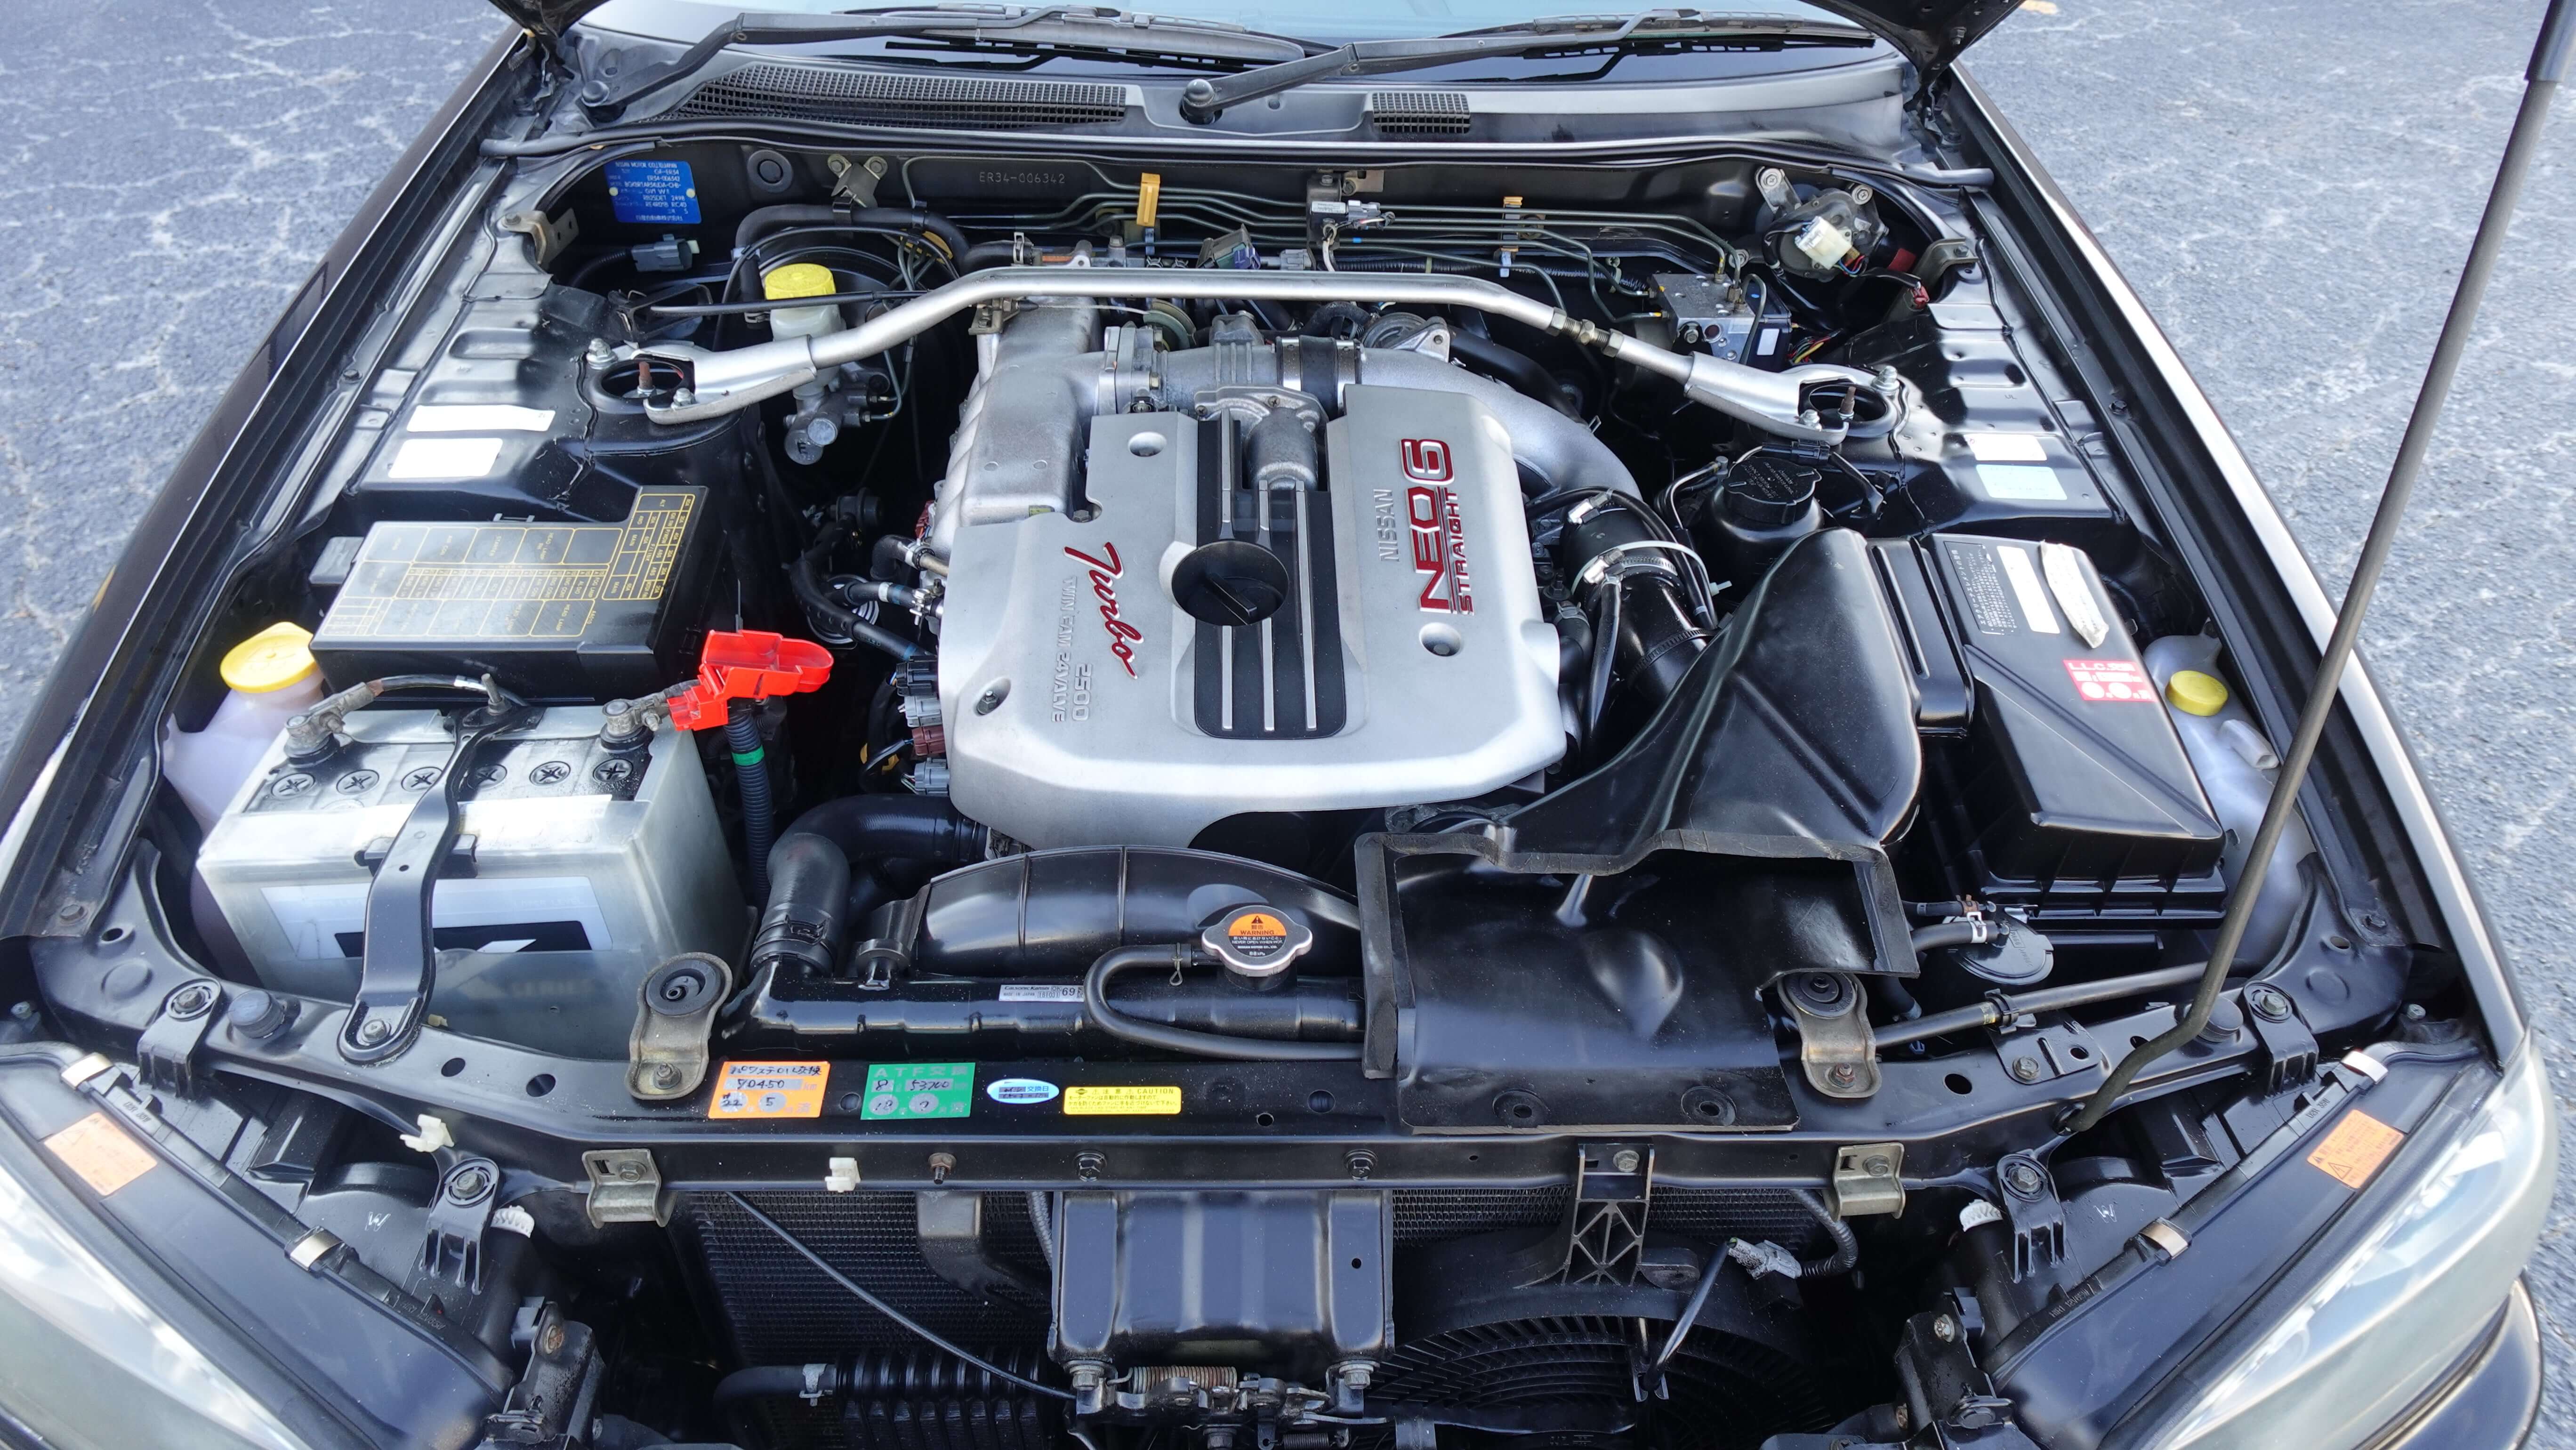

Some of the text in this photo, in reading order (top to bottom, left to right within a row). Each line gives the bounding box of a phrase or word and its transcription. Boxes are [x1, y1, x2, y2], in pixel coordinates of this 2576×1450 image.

[980, 171, 1066, 185] ER34-006342
[545, 532, 554, 545] HEAD
[1373, 488, 1400, 563] NISSAN
[1399, 438, 1457, 614] NEO 6
[629, 534, 638, 547] MAIN
[1444, 486, 1475, 616] STRAIGHT
[591, 577, 600, 587] FOG
[611, 581, 620, 594] MAIN
[1061, 575, 1078, 613] TWIN
[555, 604, 571, 632] HEAD LAMP
[1063, 541, 1144, 680] Turbo
[1050, 651, 1071, 723] 24VALVE
[1072, 662, 1093, 722] 2500
[1062, 987, 1075, 996] 69
[765, 1097, 775, 1106] 5
